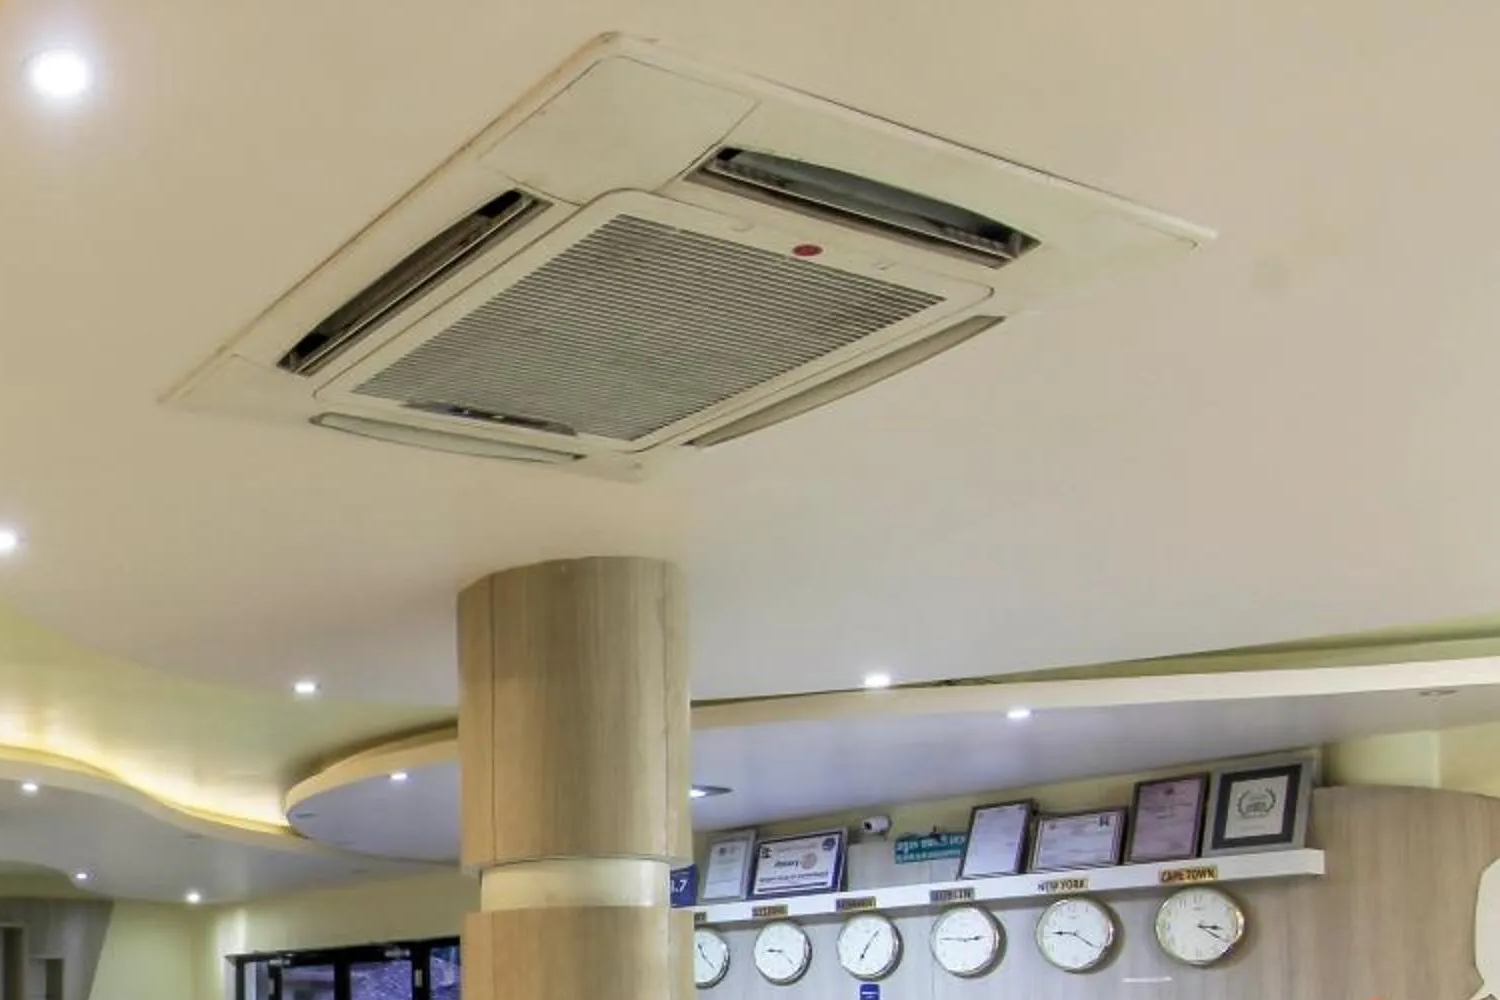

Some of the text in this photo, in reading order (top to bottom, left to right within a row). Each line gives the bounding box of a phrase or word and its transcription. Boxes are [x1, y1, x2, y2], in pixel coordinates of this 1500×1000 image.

[1160, 867, 1215, 882] CAPE TOWN
[1037, 879, 1086, 893] NEW YORK
